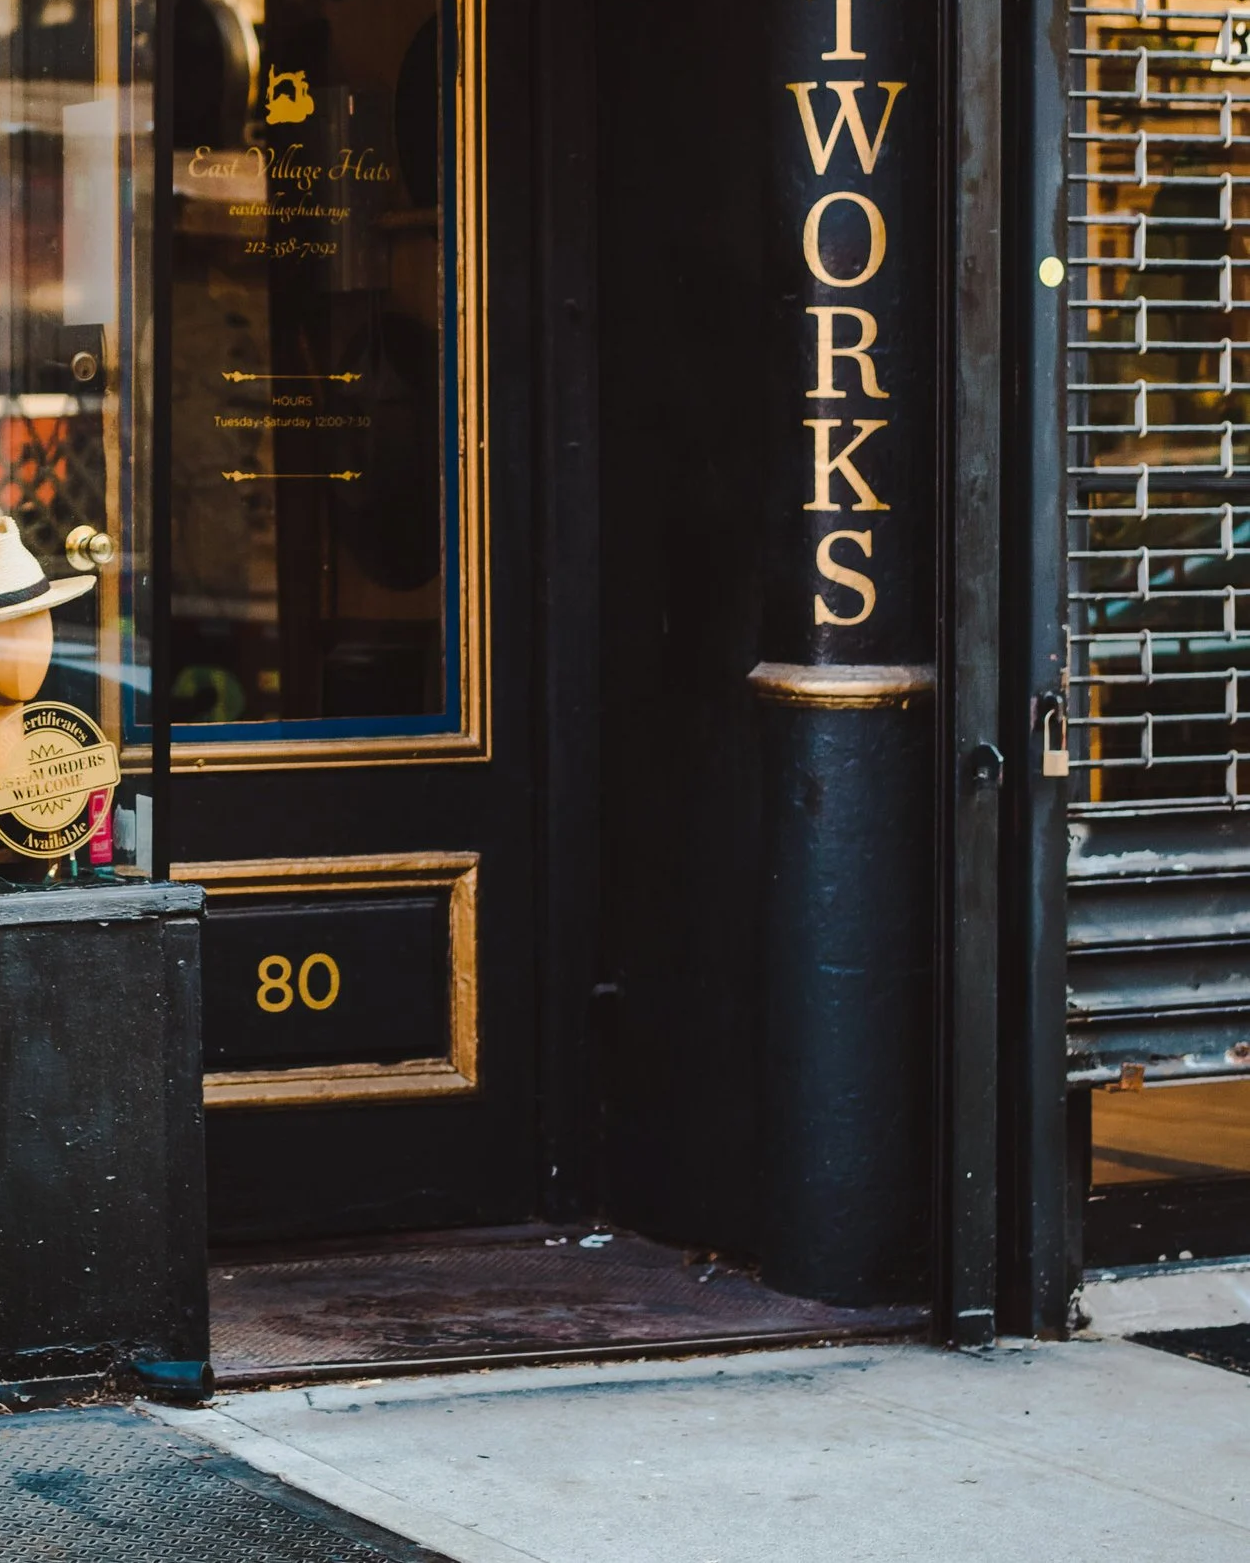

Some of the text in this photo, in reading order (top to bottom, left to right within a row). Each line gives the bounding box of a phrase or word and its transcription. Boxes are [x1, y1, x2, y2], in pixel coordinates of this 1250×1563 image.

[188, 143, 391, 190] East Village Hats
[243, 237, 338, 259] 212-358-7092
[272, 395, 313, 407] HOURS
[22, 711, 89, 743] ertificates
[48, 753, 107, 778] ORDERS
[12, 772, 84, 801] WELCOME
[22, 821, 88, 851] Available
[256, 952, 341, 1013] 80
